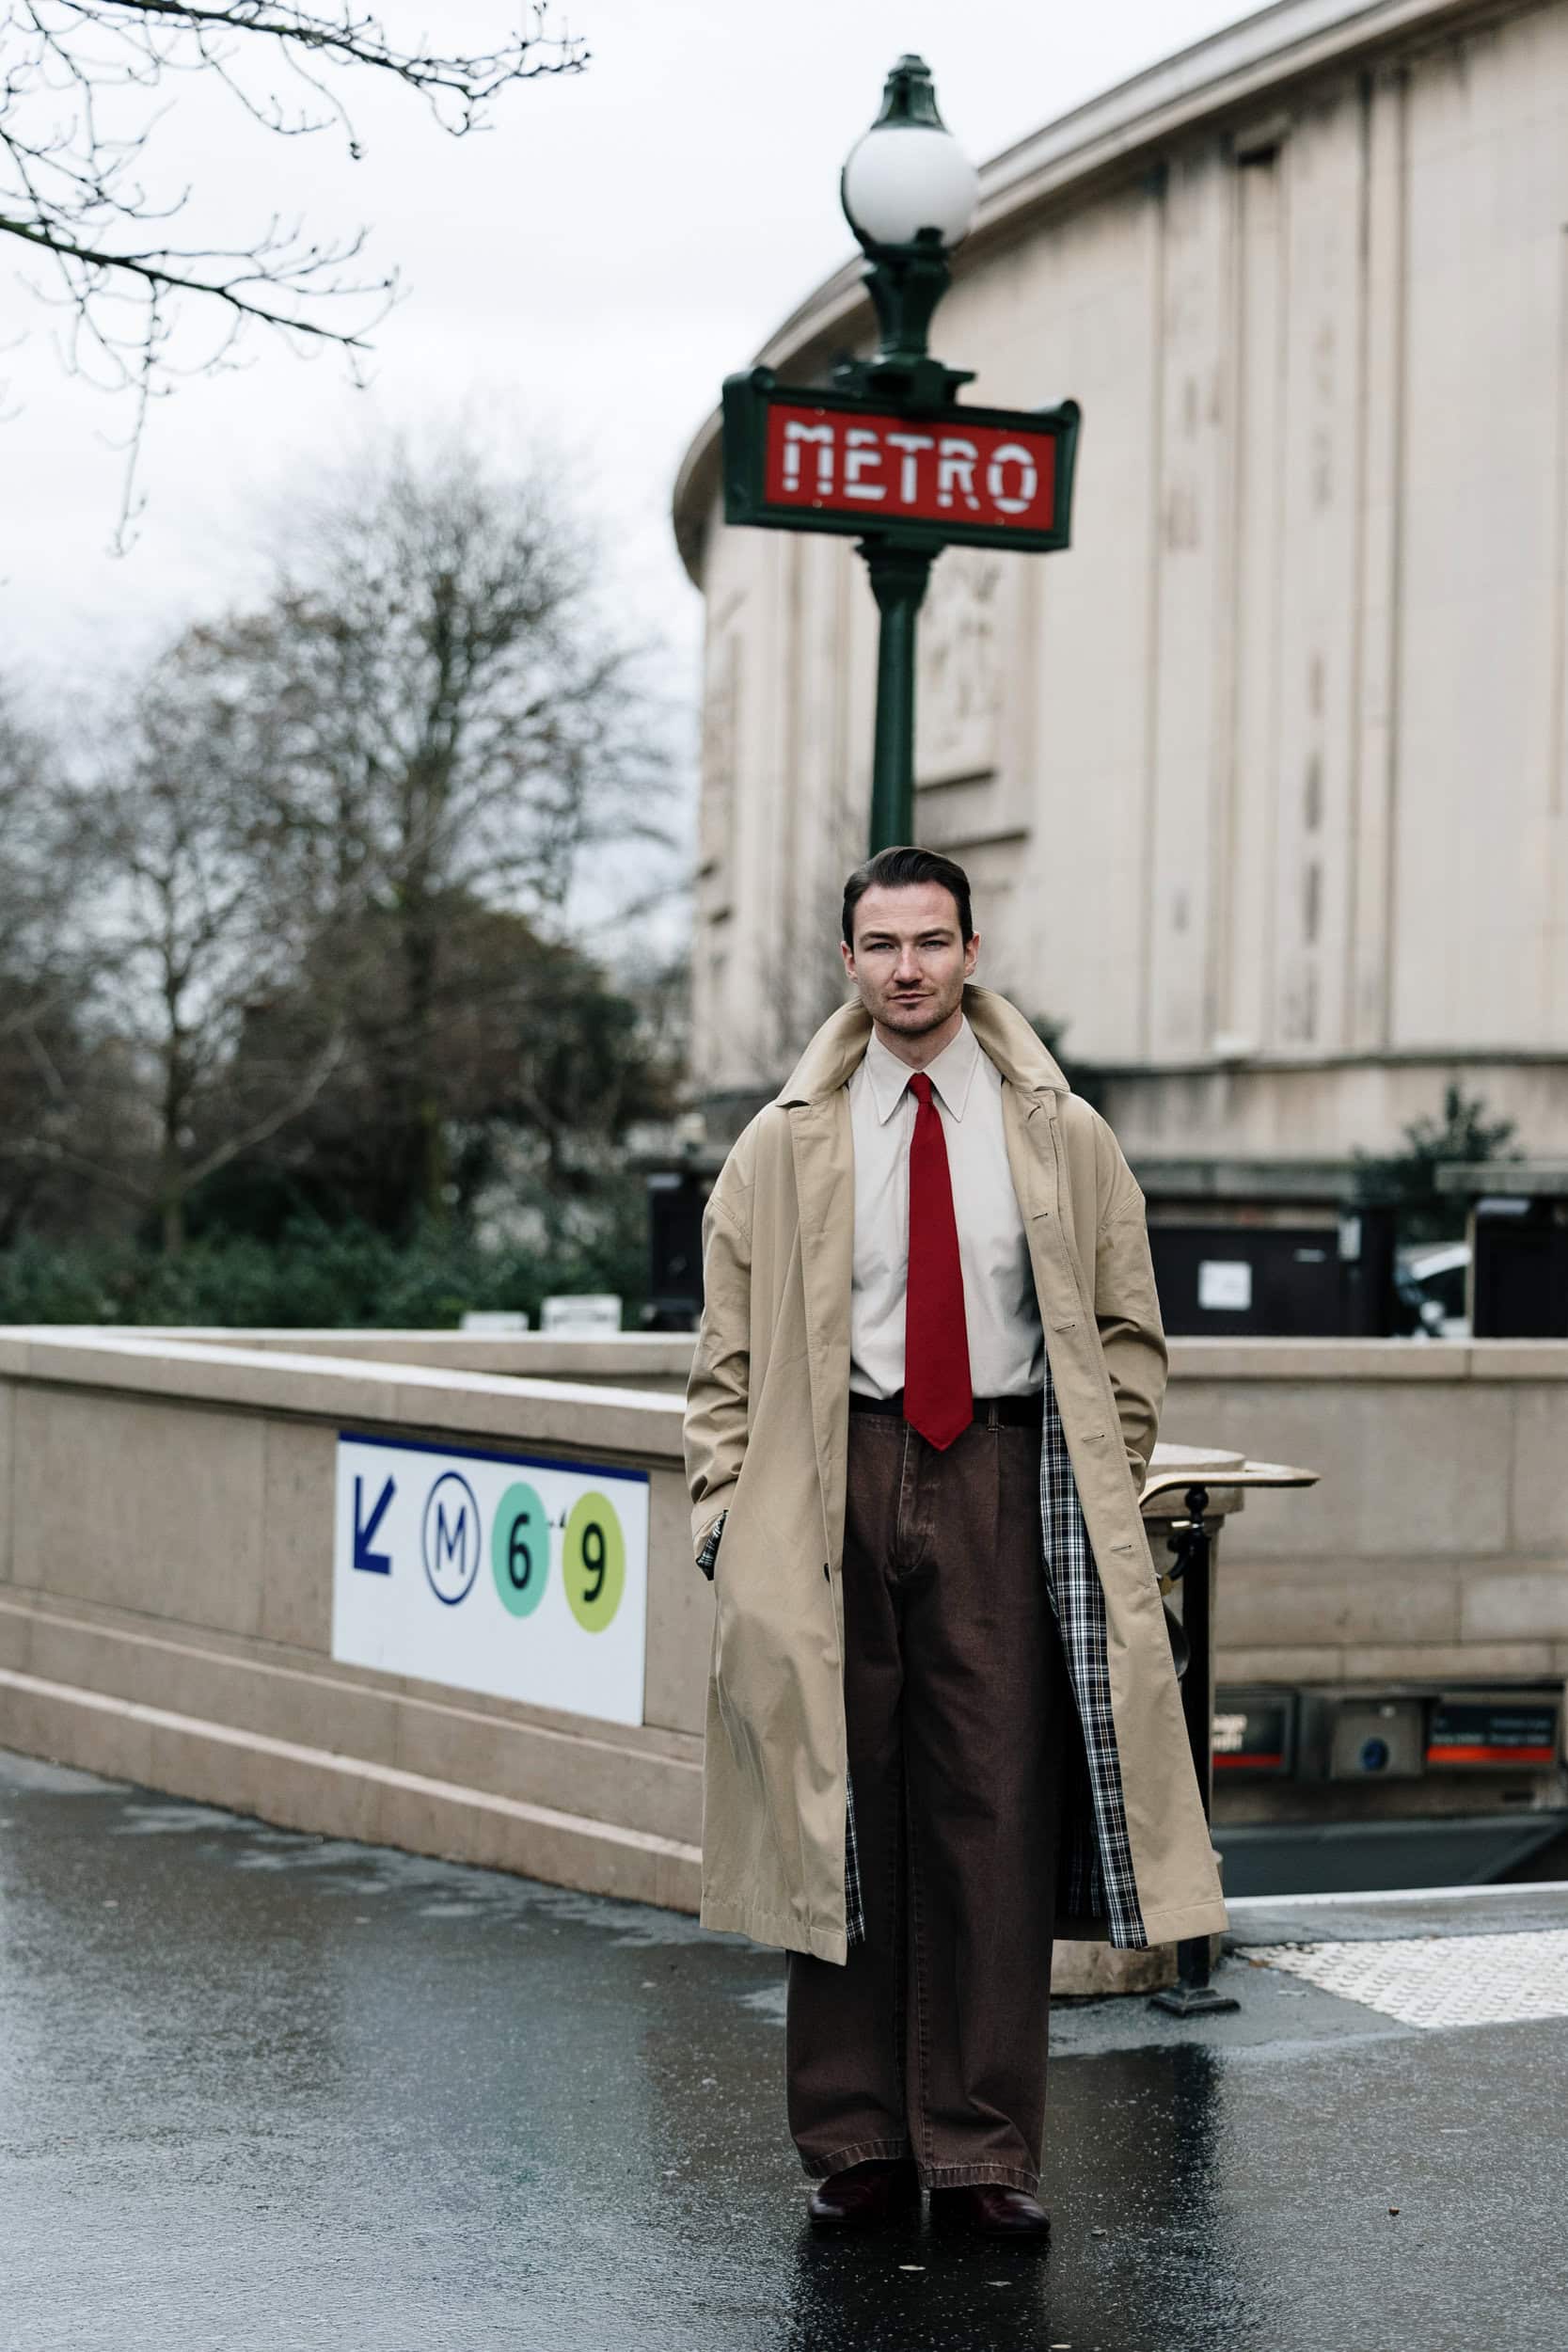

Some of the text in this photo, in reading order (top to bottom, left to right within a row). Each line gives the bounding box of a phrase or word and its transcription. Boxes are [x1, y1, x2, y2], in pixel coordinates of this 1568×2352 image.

[782, 421, 1037, 514] METRO
[436, 1501, 607, 1604] M 6 9
